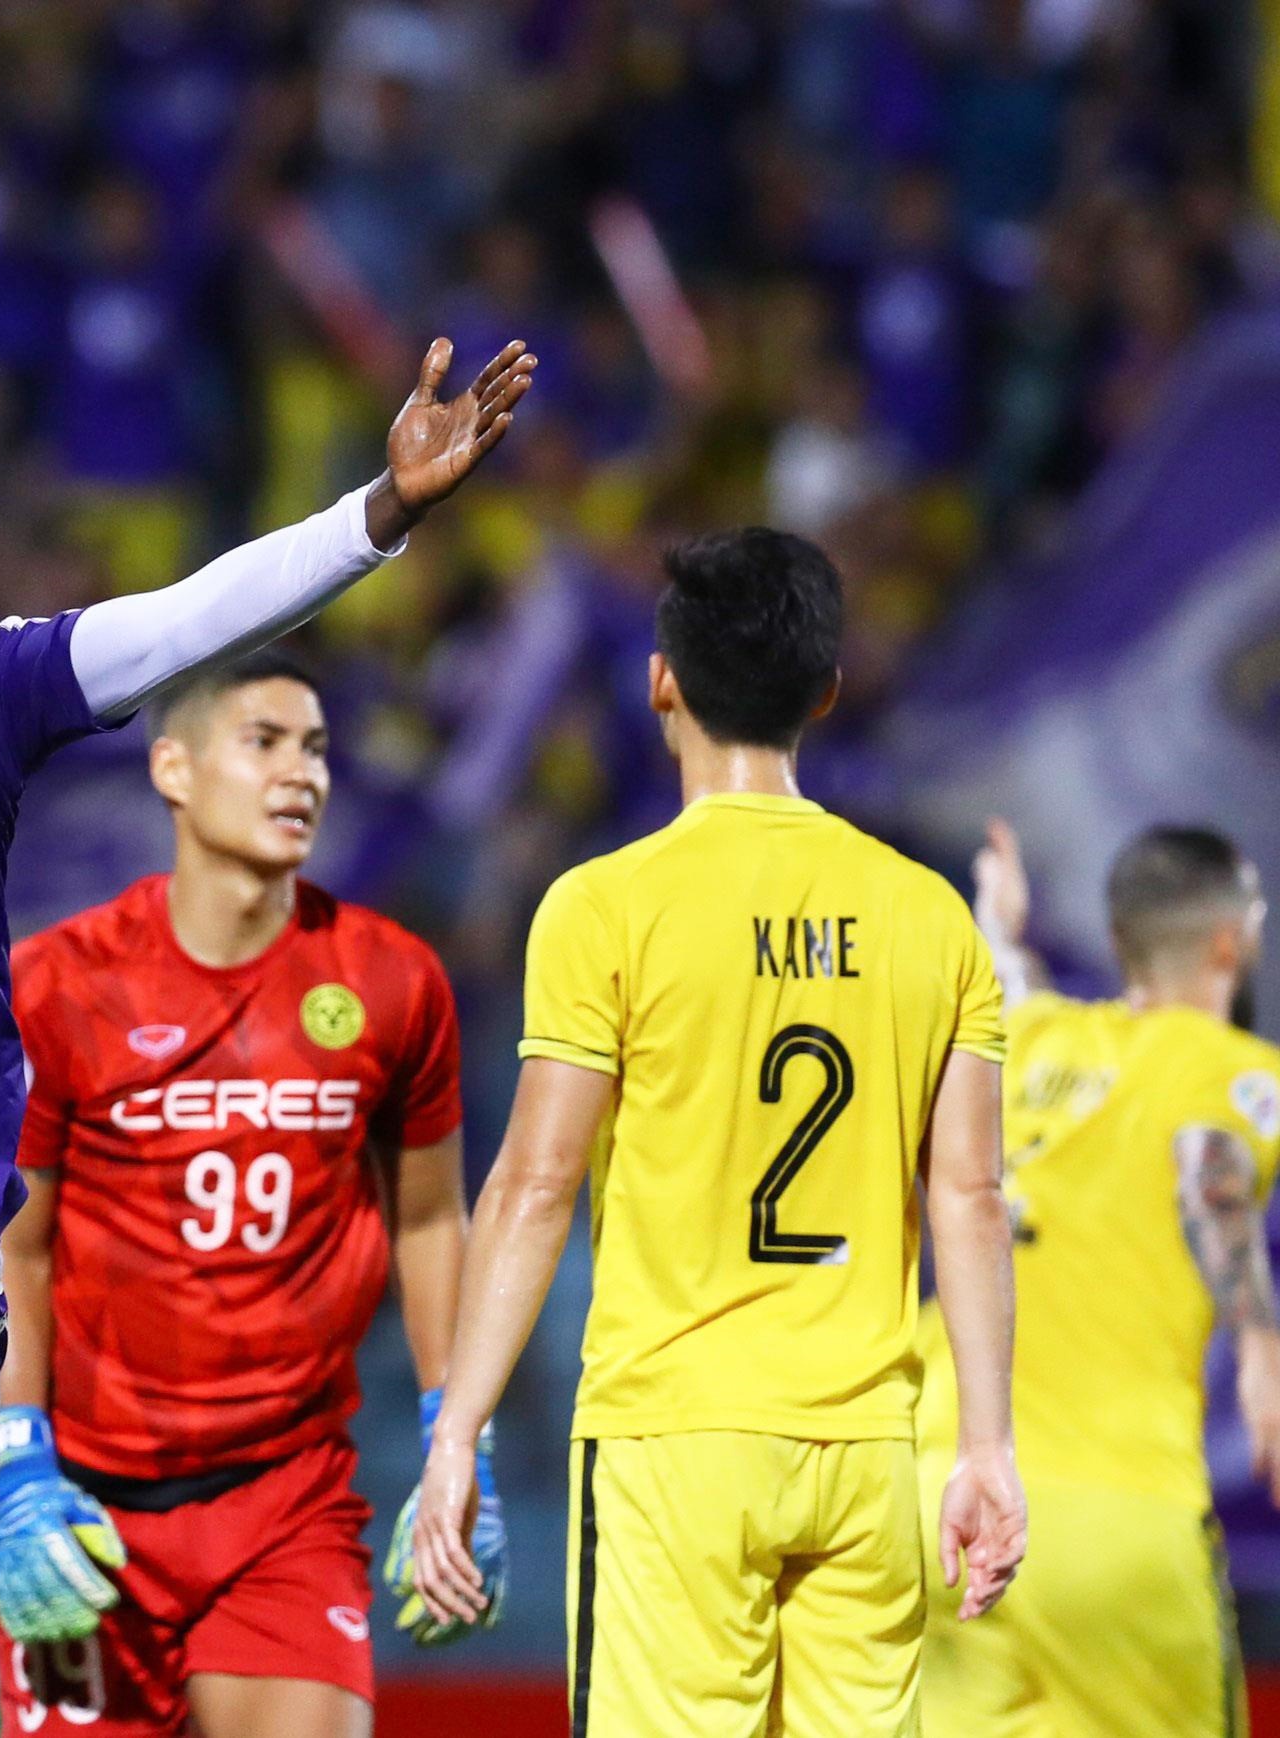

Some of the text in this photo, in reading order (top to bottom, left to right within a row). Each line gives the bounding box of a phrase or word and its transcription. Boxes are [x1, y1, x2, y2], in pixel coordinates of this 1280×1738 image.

[753, 916, 860, 979] KANE
[110, 1079, 361, 1131] CERES
[749, 1023, 854, 1265] 2
[181, 1150, 293, 1254] 99
